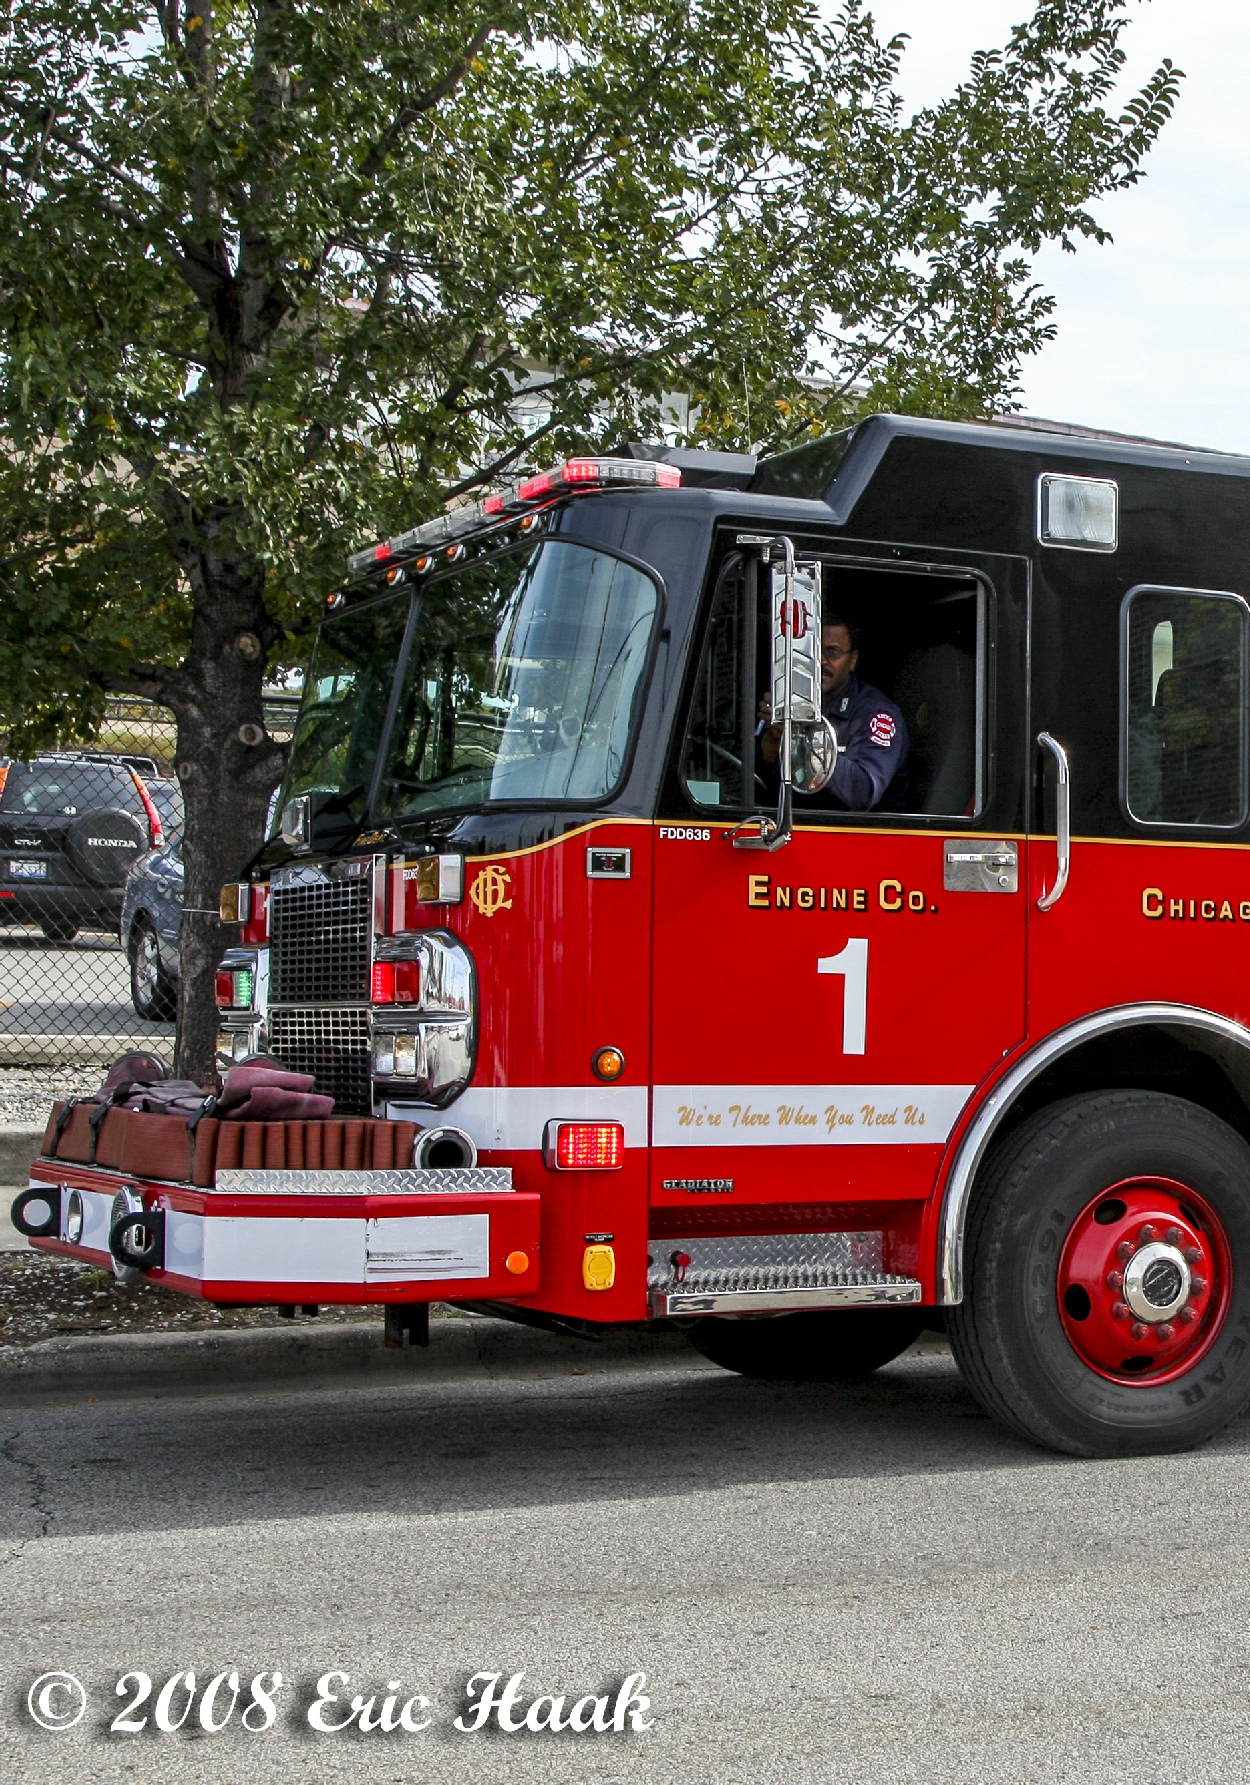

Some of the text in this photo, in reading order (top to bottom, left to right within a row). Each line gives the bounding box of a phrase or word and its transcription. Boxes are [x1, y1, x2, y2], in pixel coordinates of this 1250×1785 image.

[87, 837, 138, 849] HONDA
[659, 827, 711, 841] FDD636
[748, 874, 867, 911] ENGINE
[817, 937, 869, 1055] 1
[677, 1104, 926, 1135] We're There When You Need Us
[663, 1179, 734, 1189] GLADIATOR
